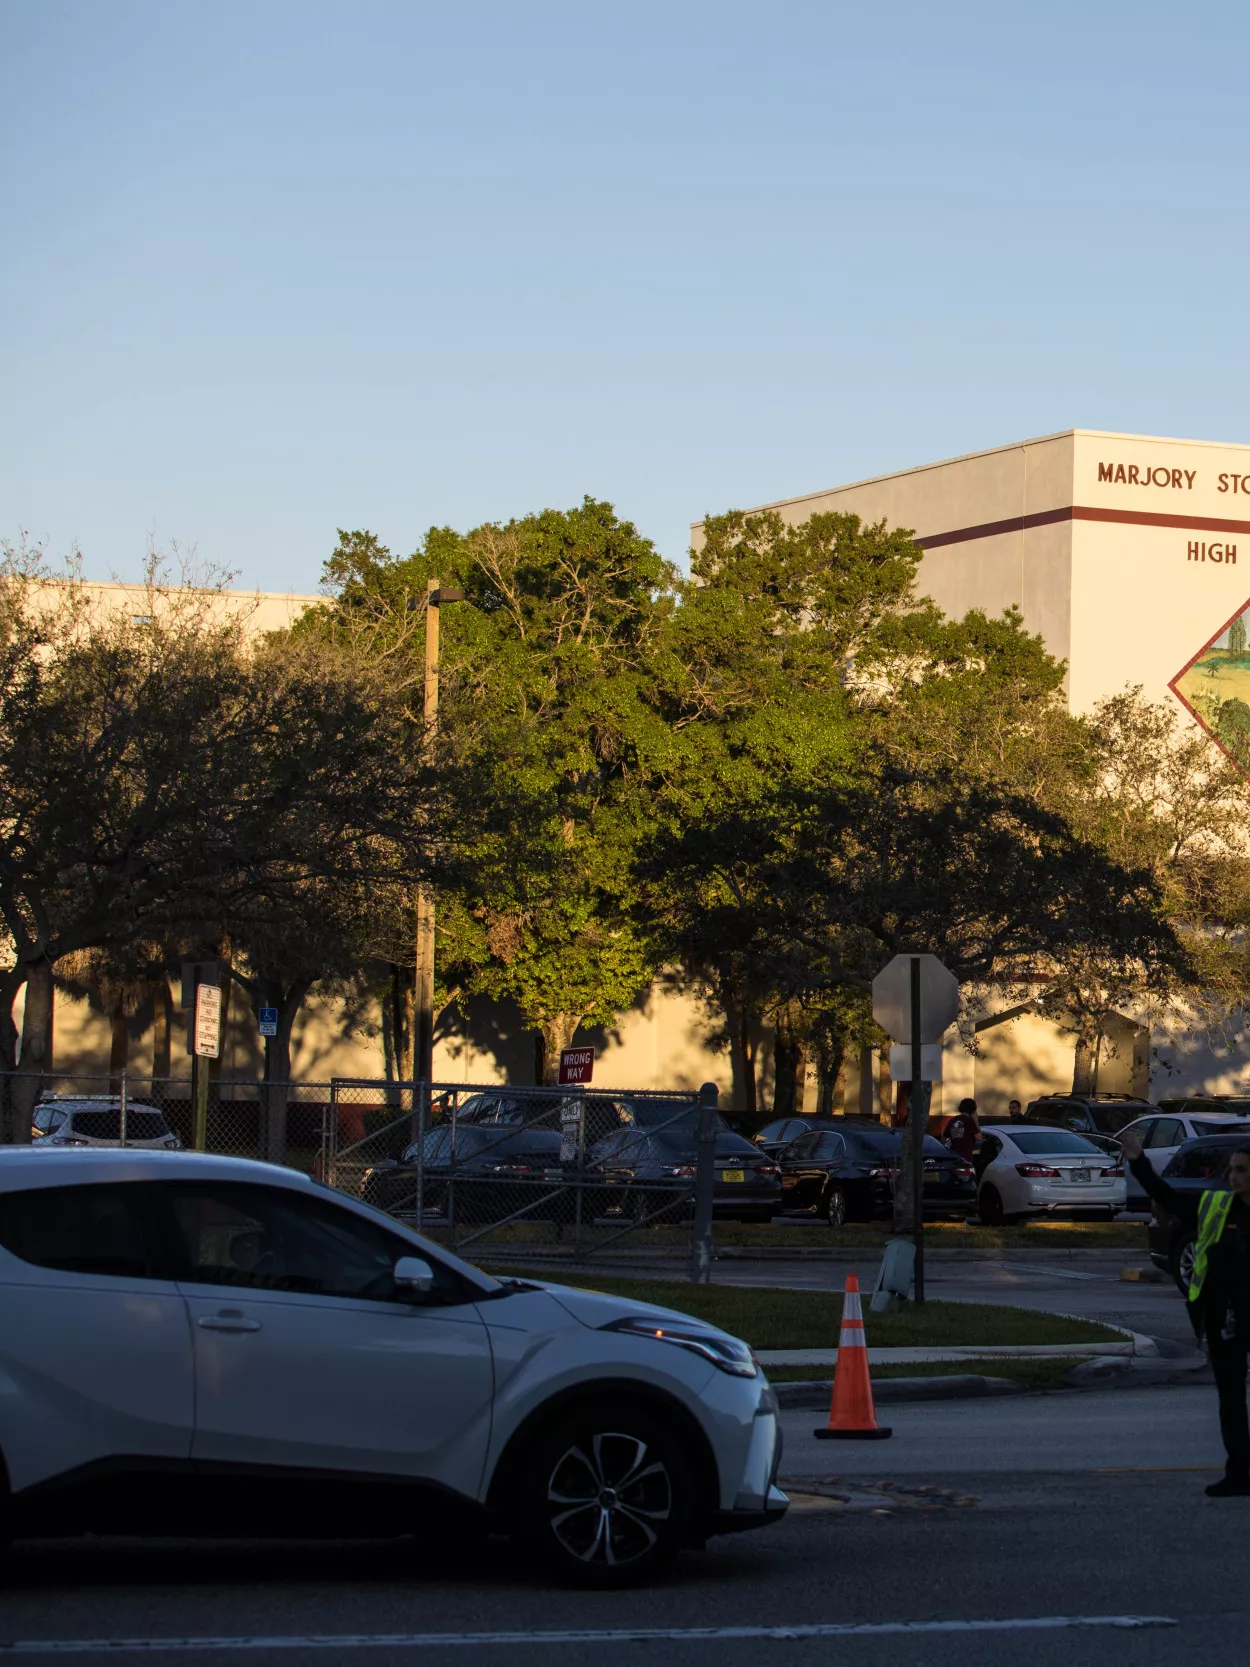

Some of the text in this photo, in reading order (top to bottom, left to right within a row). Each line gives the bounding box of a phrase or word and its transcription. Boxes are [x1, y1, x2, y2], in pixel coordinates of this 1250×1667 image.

[1097, 461, 1197, 490] MARJORY
[1187, 540, 1237, 565] HIGH
[564, 1053, 591, 1066] WRONG
[567, 1067, 584, 1079] WAY
